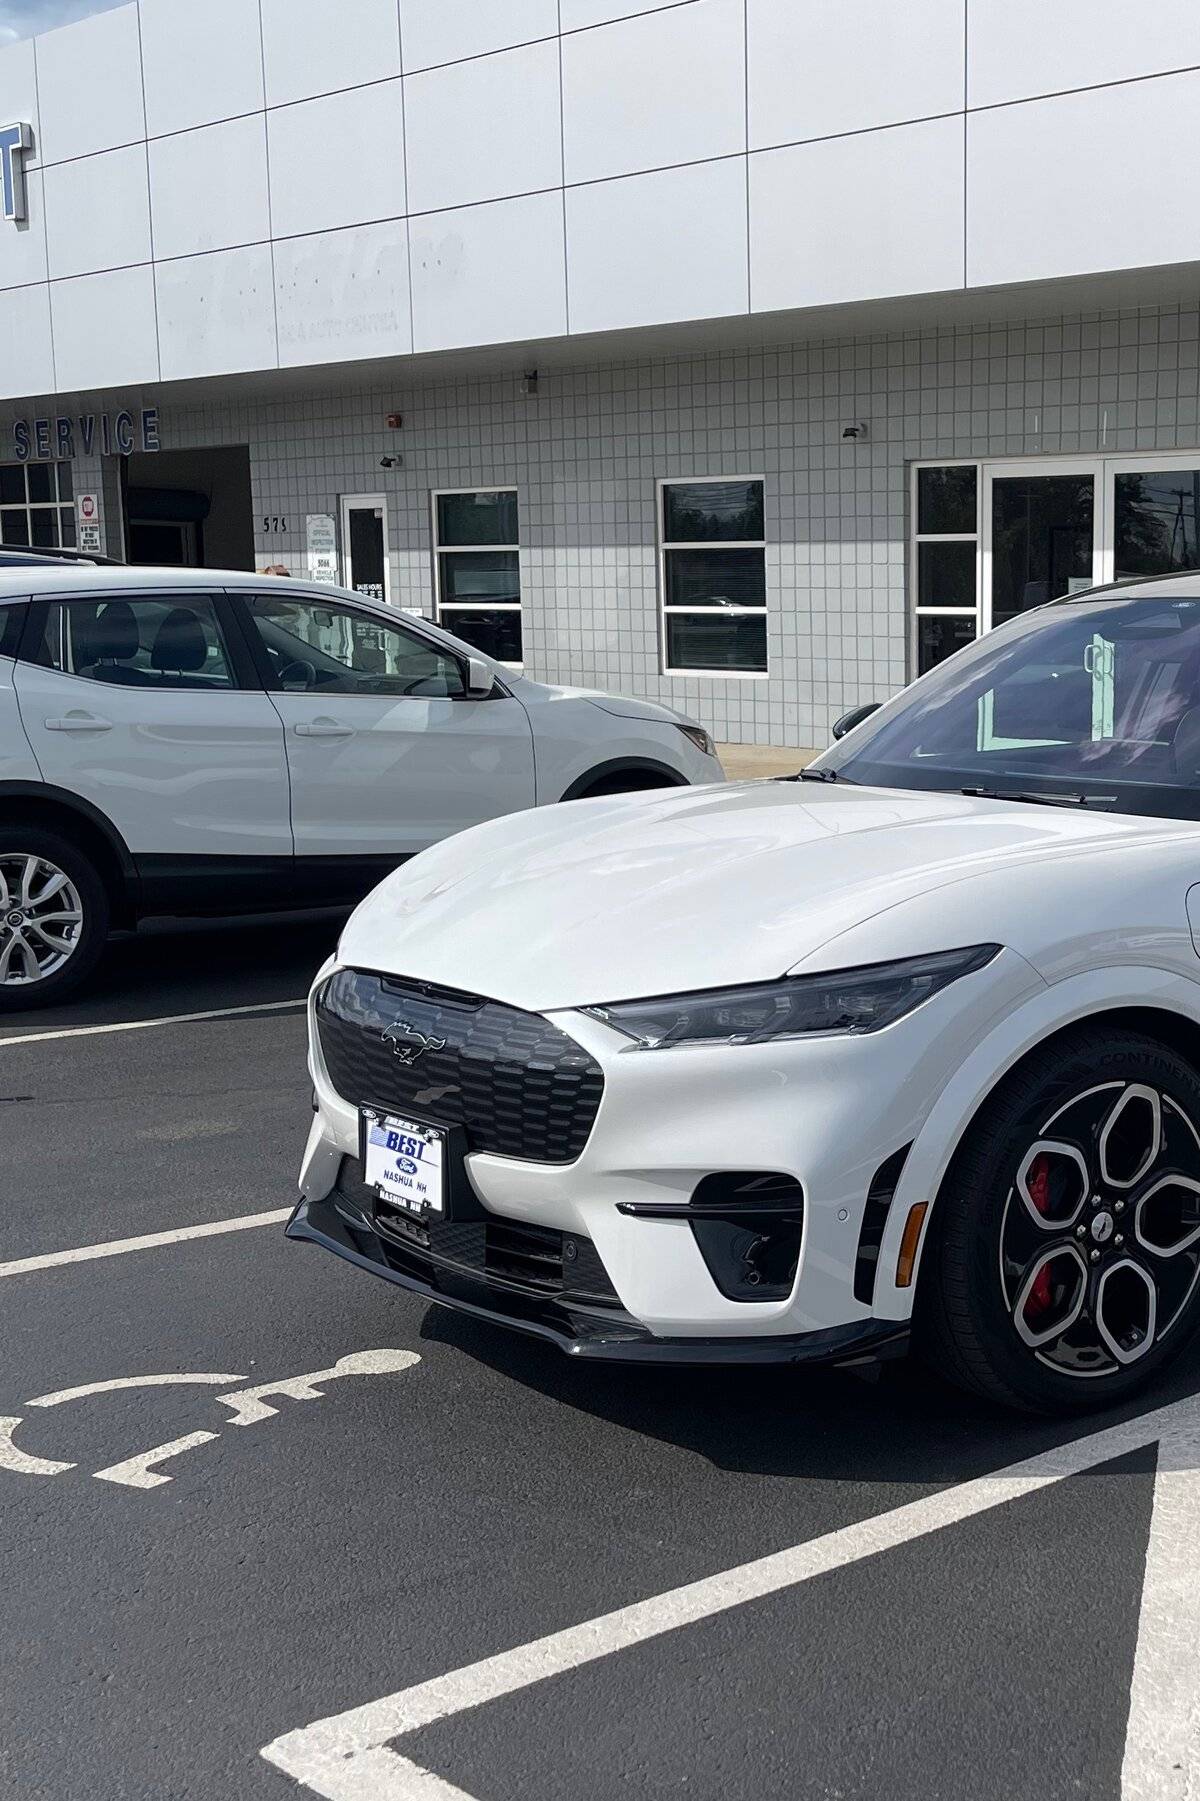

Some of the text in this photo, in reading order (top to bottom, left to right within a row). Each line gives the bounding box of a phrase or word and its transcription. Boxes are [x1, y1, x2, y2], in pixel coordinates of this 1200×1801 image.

[13, 408, 160, 462] SERVICE
[386, 1130, 426, 1160] BEST
[398, 1158, 416, 1175] Ford
[383, 1169, 428, 1193] NASHUA NH
[379, 1190, 408, 1208] NASHUA
